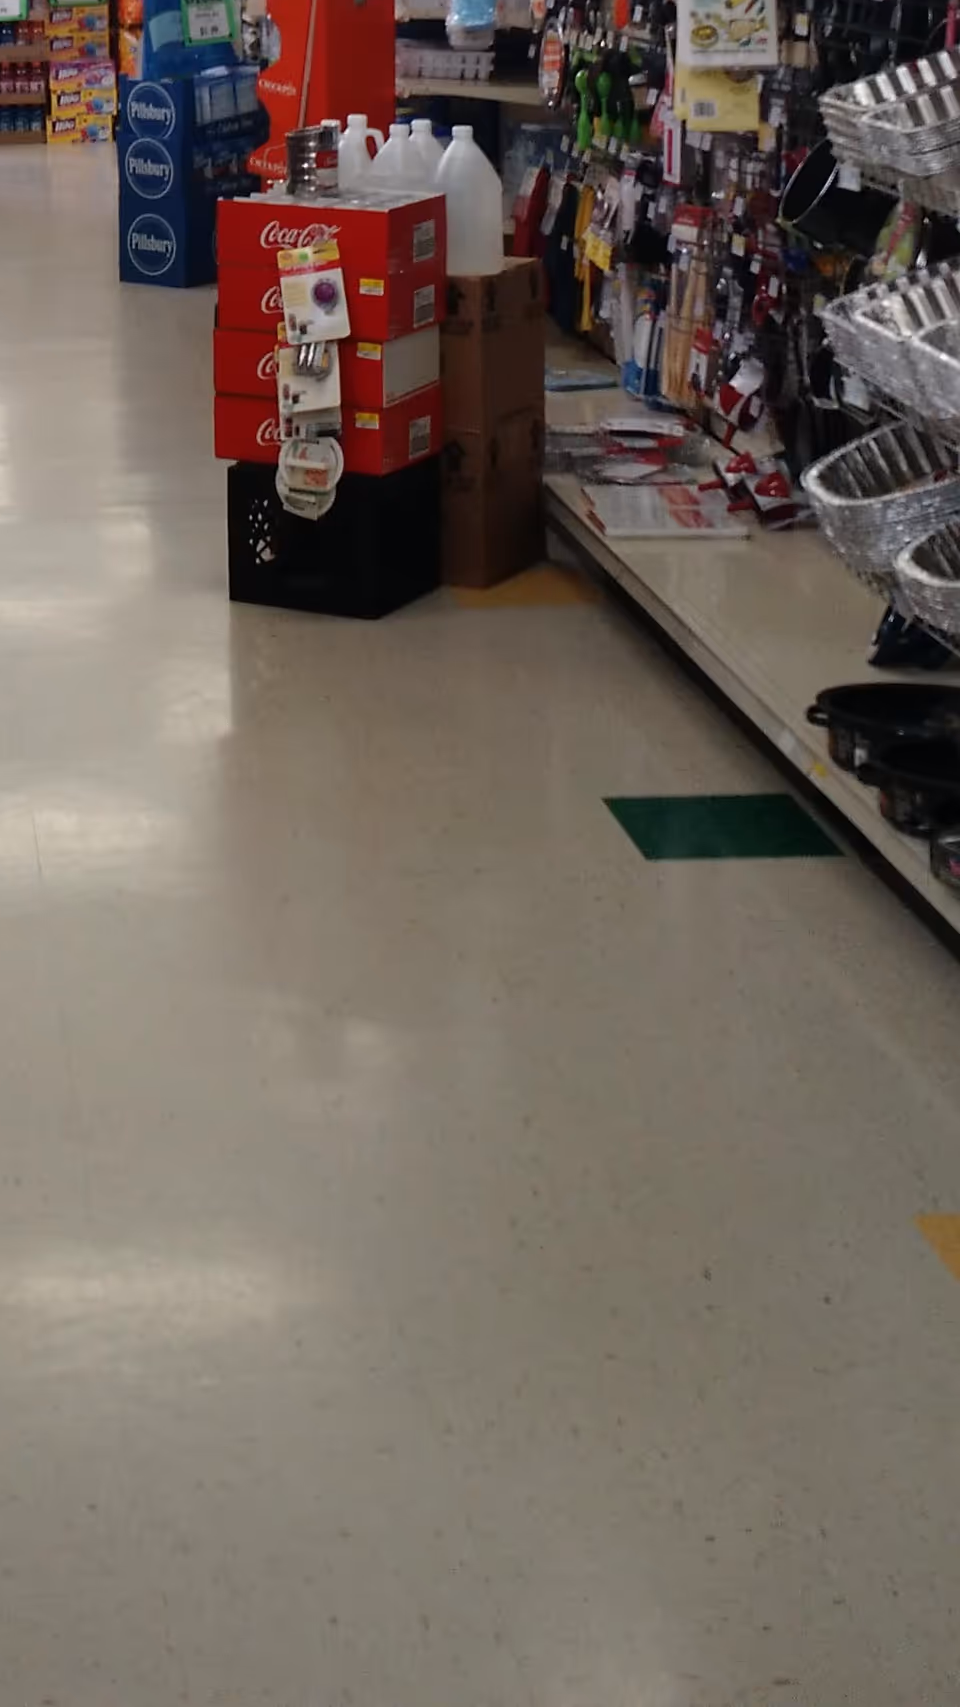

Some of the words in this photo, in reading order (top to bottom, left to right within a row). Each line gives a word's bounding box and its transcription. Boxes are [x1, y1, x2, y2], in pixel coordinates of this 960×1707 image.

[130, 101, 173, 123] Pillsbury
[128, 158, 171, 179] Pillsbury
[131, 232, 174, 256] Pillsbury
